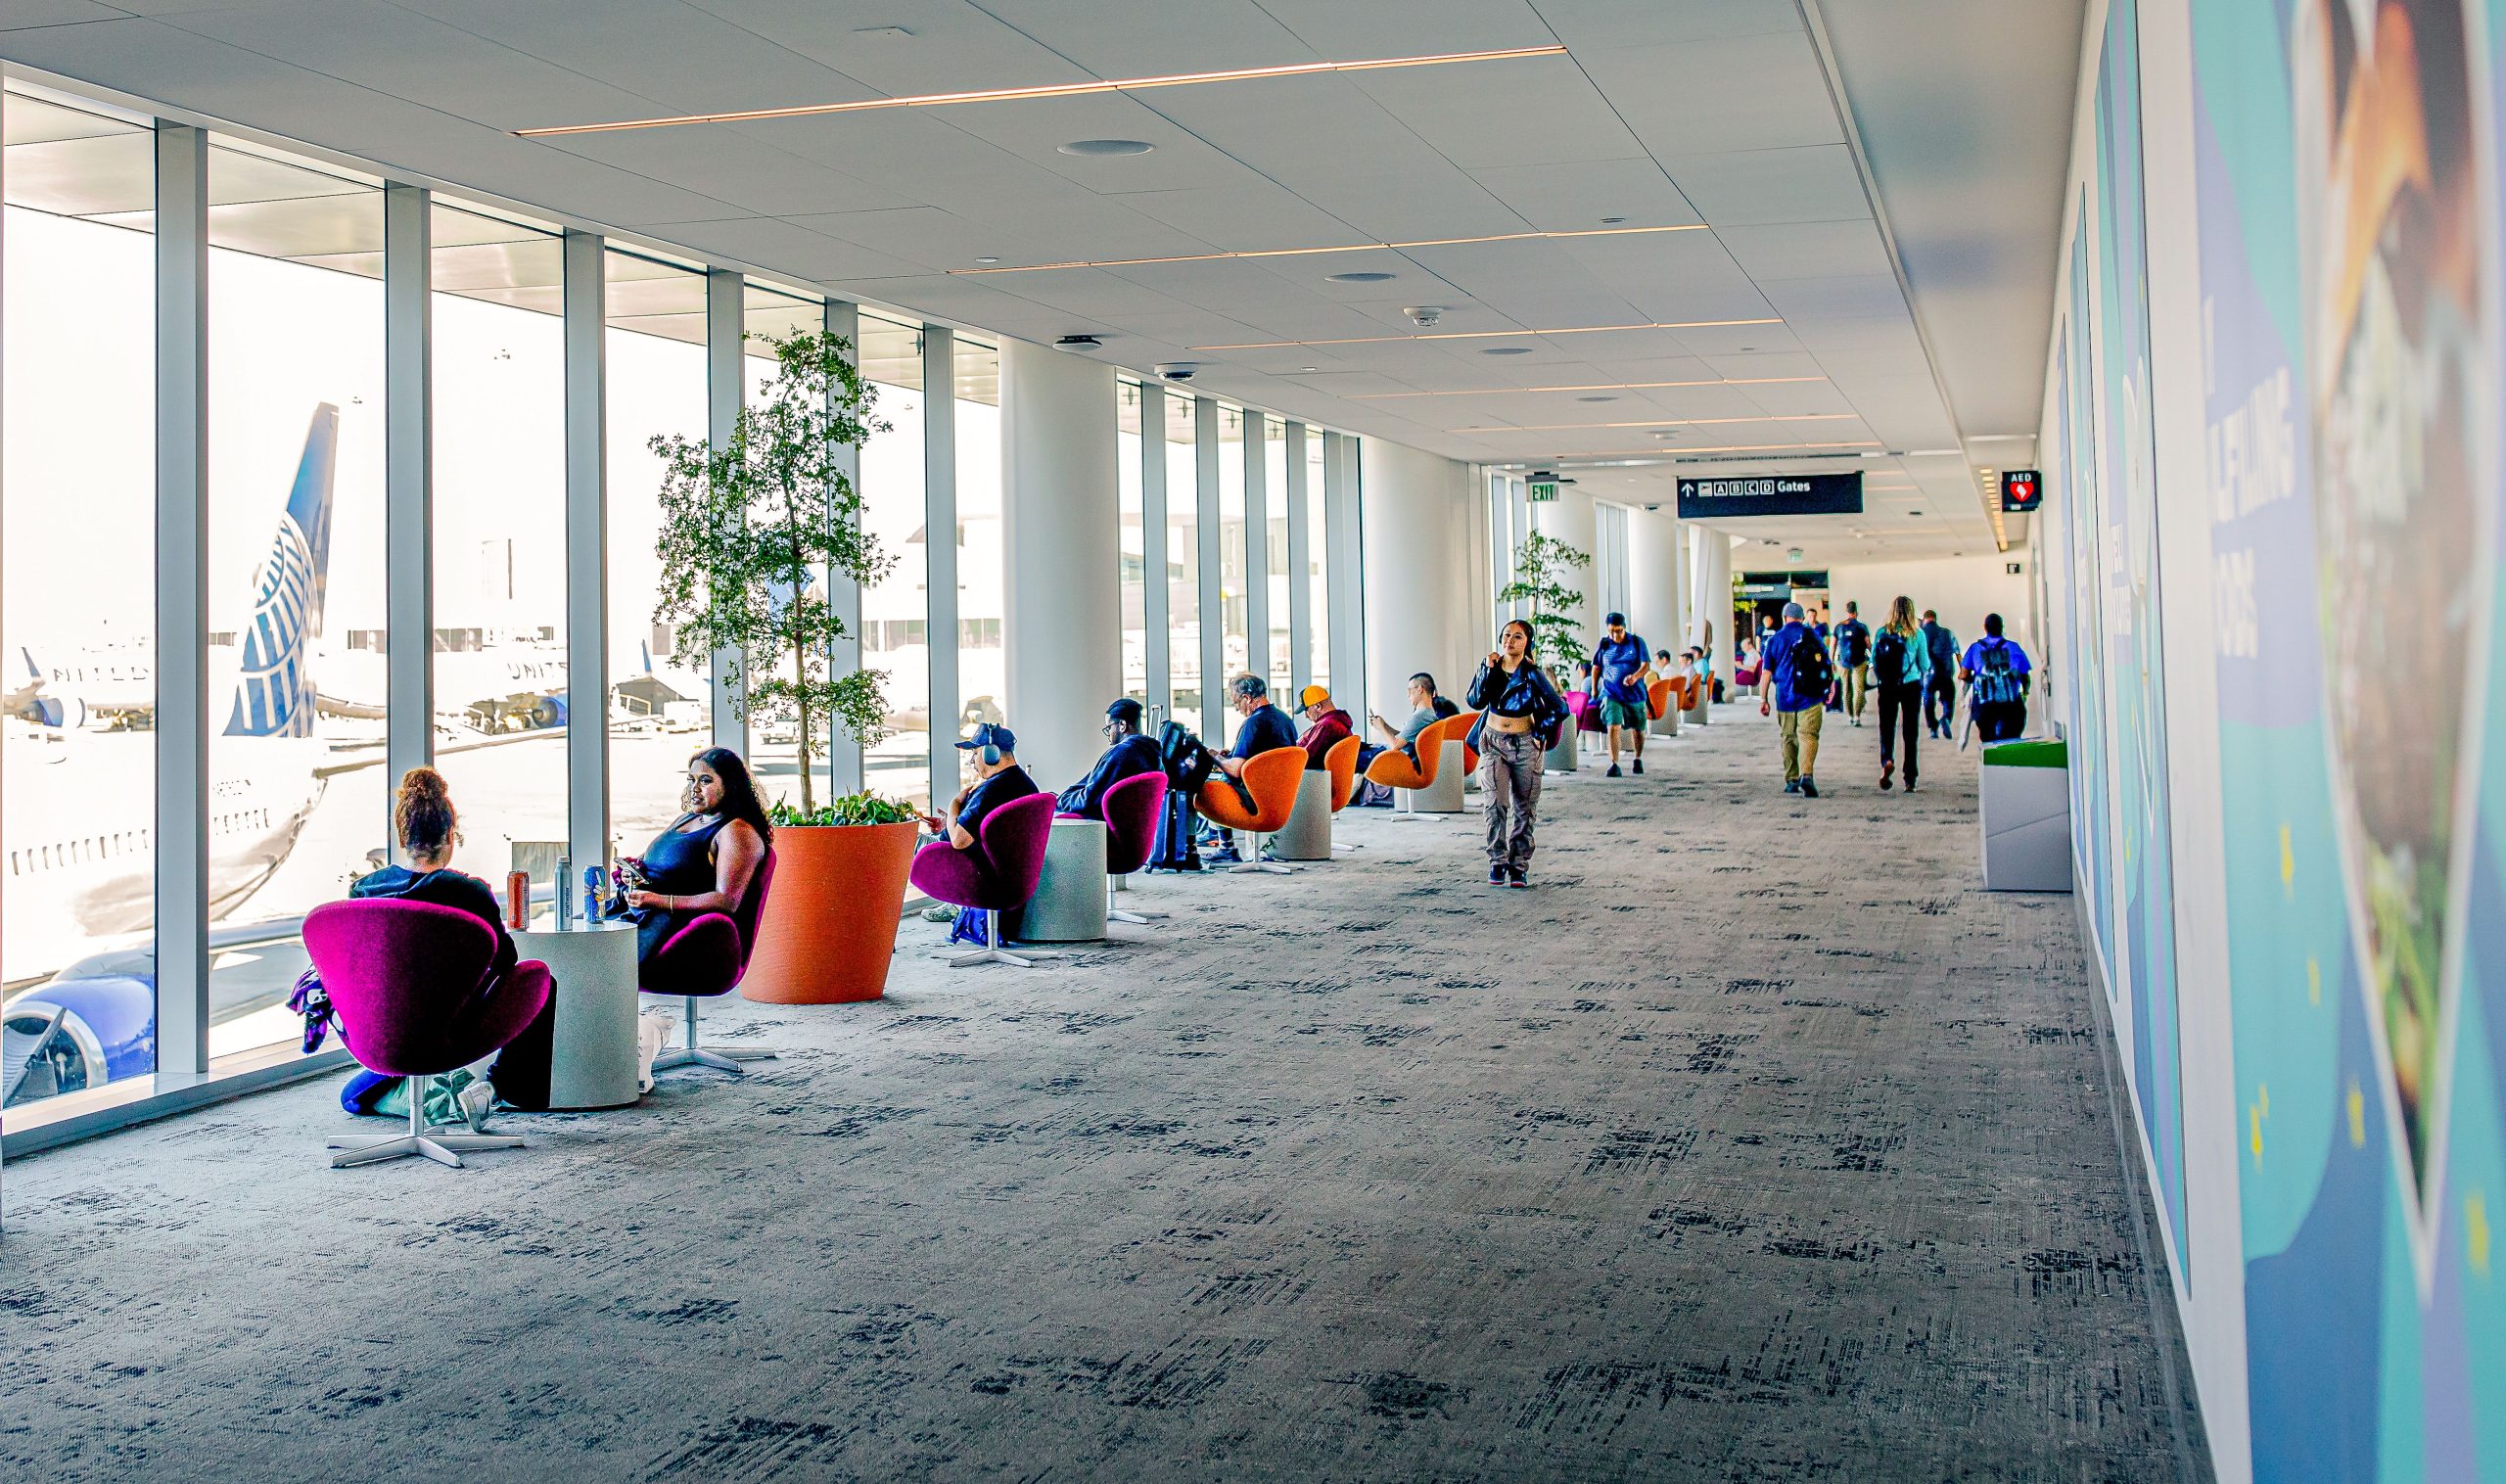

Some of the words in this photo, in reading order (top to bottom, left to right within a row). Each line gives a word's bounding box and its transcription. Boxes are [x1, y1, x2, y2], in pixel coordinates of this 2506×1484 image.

[2011, 473, 2032, 483] AED
[1777, 481, 1811, 492] Gates
[1532, 485, 1555, 501] EXIT
